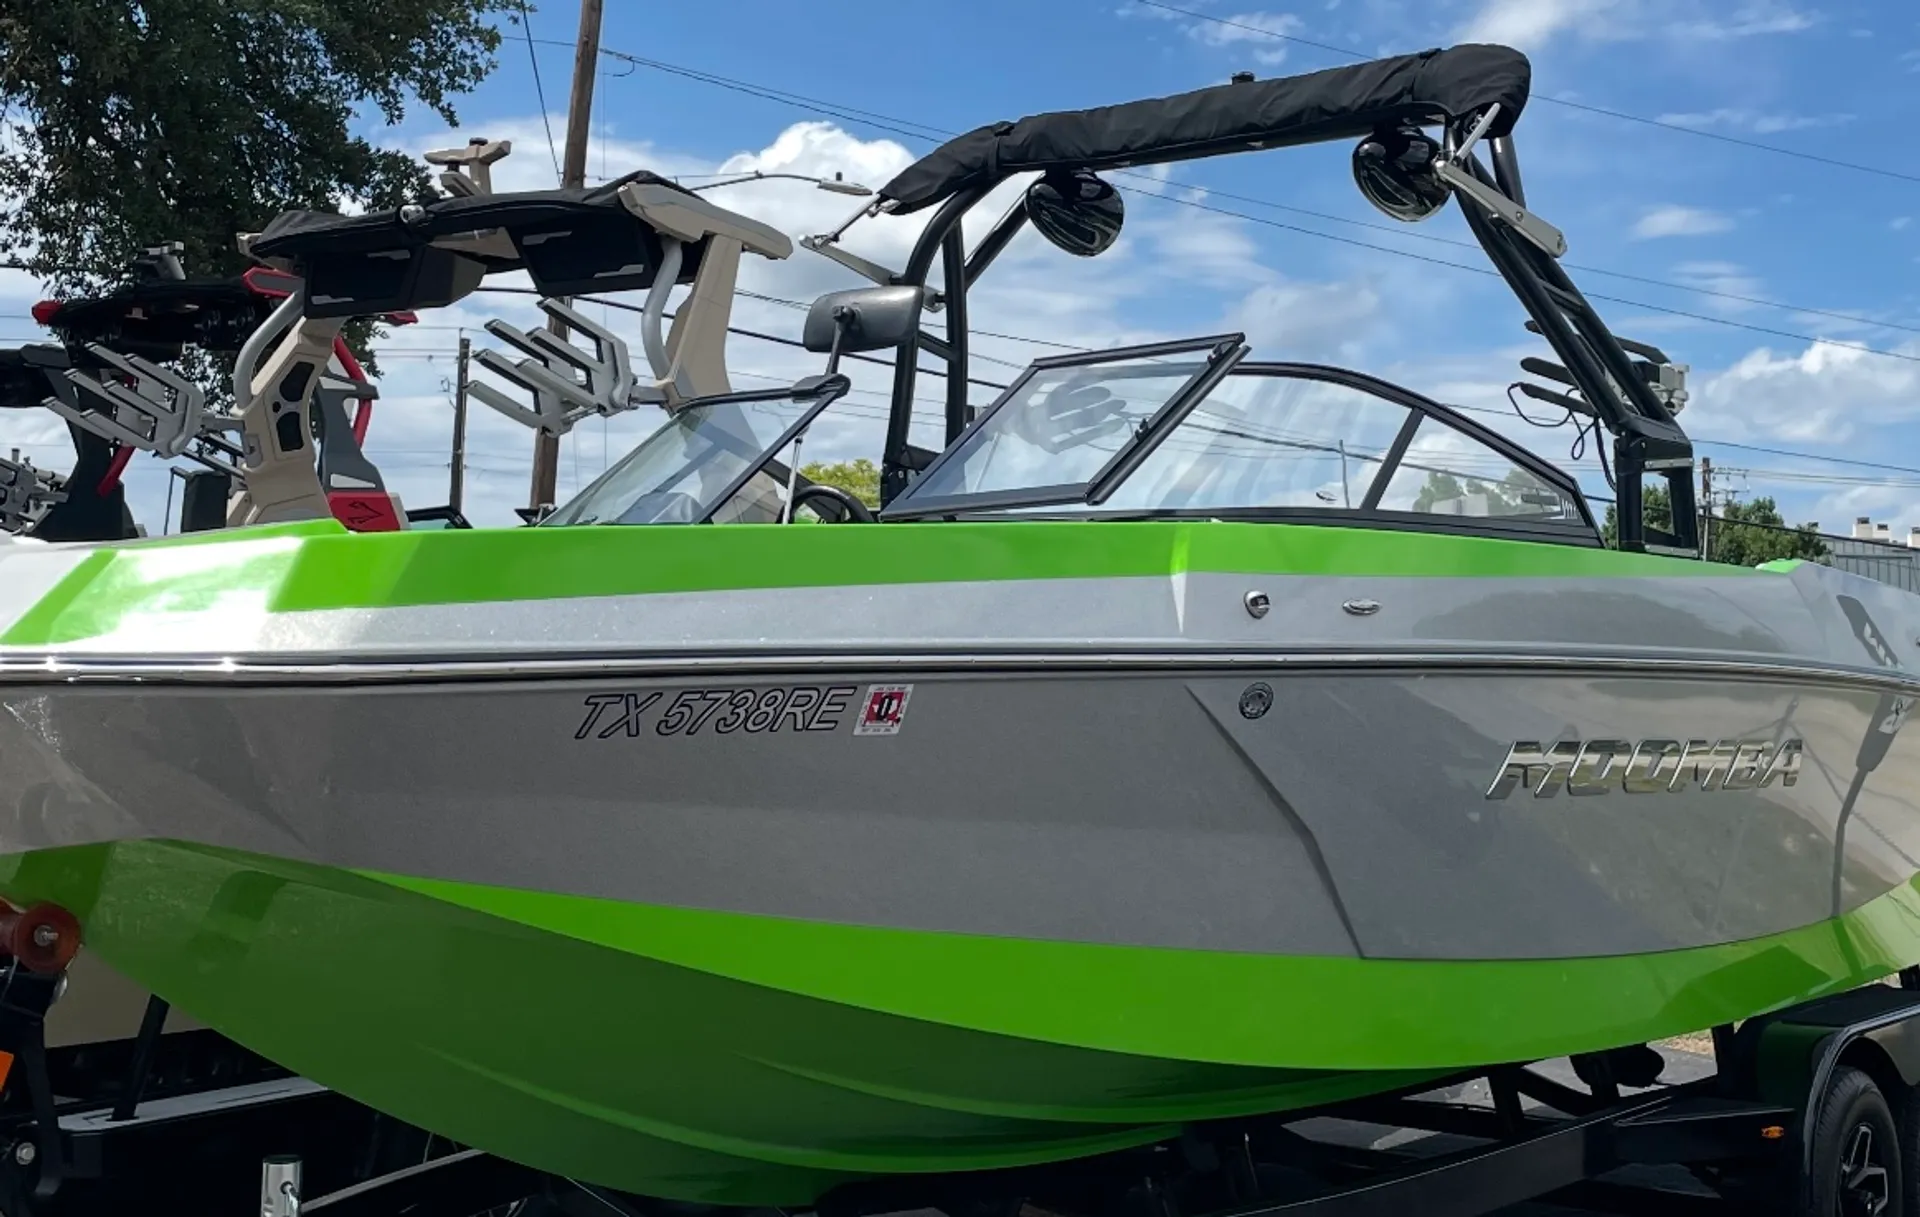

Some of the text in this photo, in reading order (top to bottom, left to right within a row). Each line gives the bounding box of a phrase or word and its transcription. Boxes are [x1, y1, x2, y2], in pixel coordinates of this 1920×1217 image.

[574, 692, 663, 739] TX
[656, 687, 857, 735] 5738RE
[1485, 739, 1803, 799] MOOMBA
